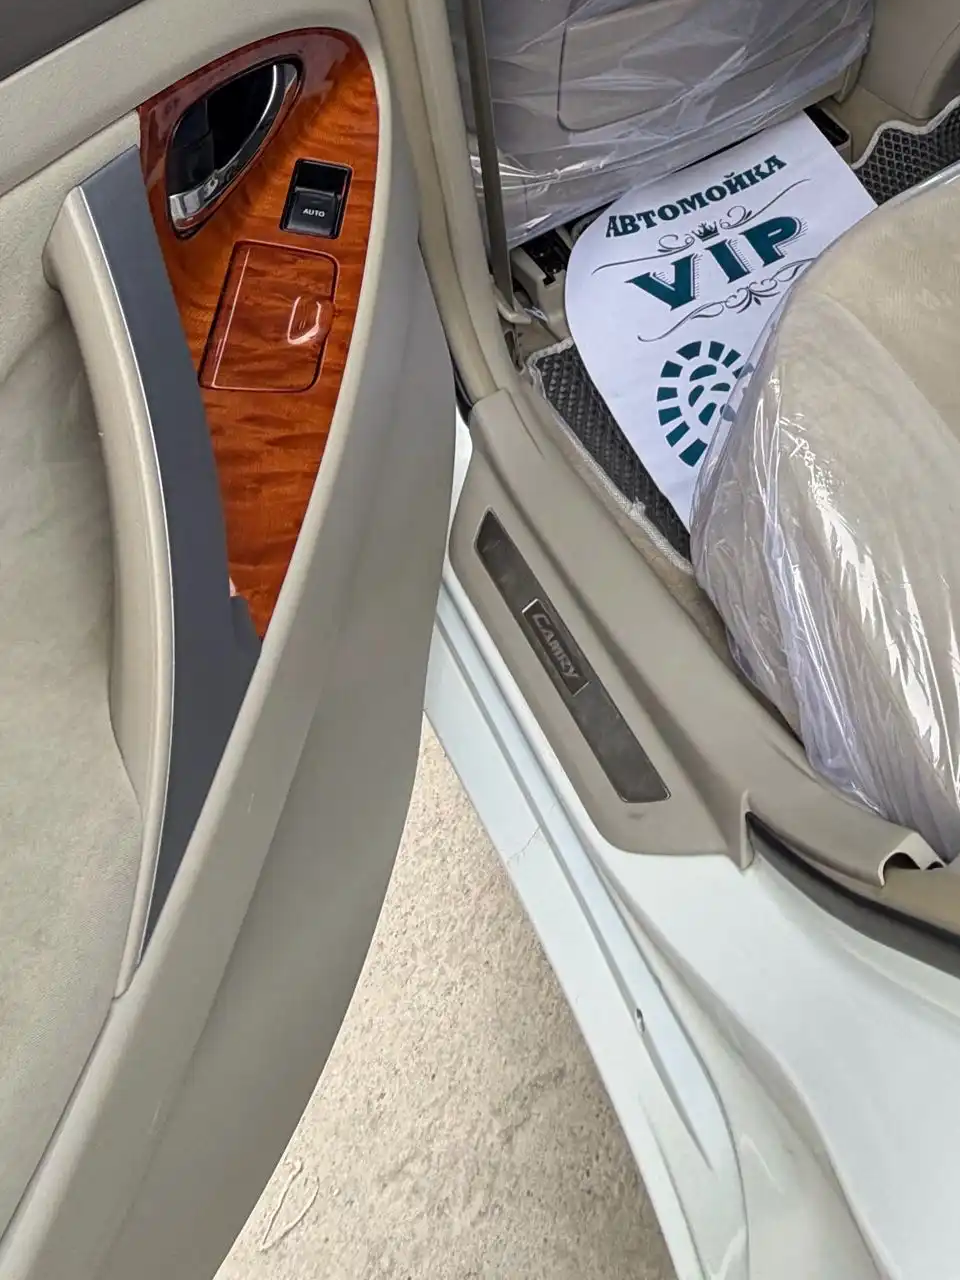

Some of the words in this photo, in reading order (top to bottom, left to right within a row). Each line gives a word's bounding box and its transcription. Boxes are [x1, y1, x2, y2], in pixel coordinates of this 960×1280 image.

[302, 208, 326, 218] AUTO
[605, 154, 786, 238] АВТОМОЙКА
[624, 215, 808, 311] VIP
[532, 613, 580, 678] CAMRY
